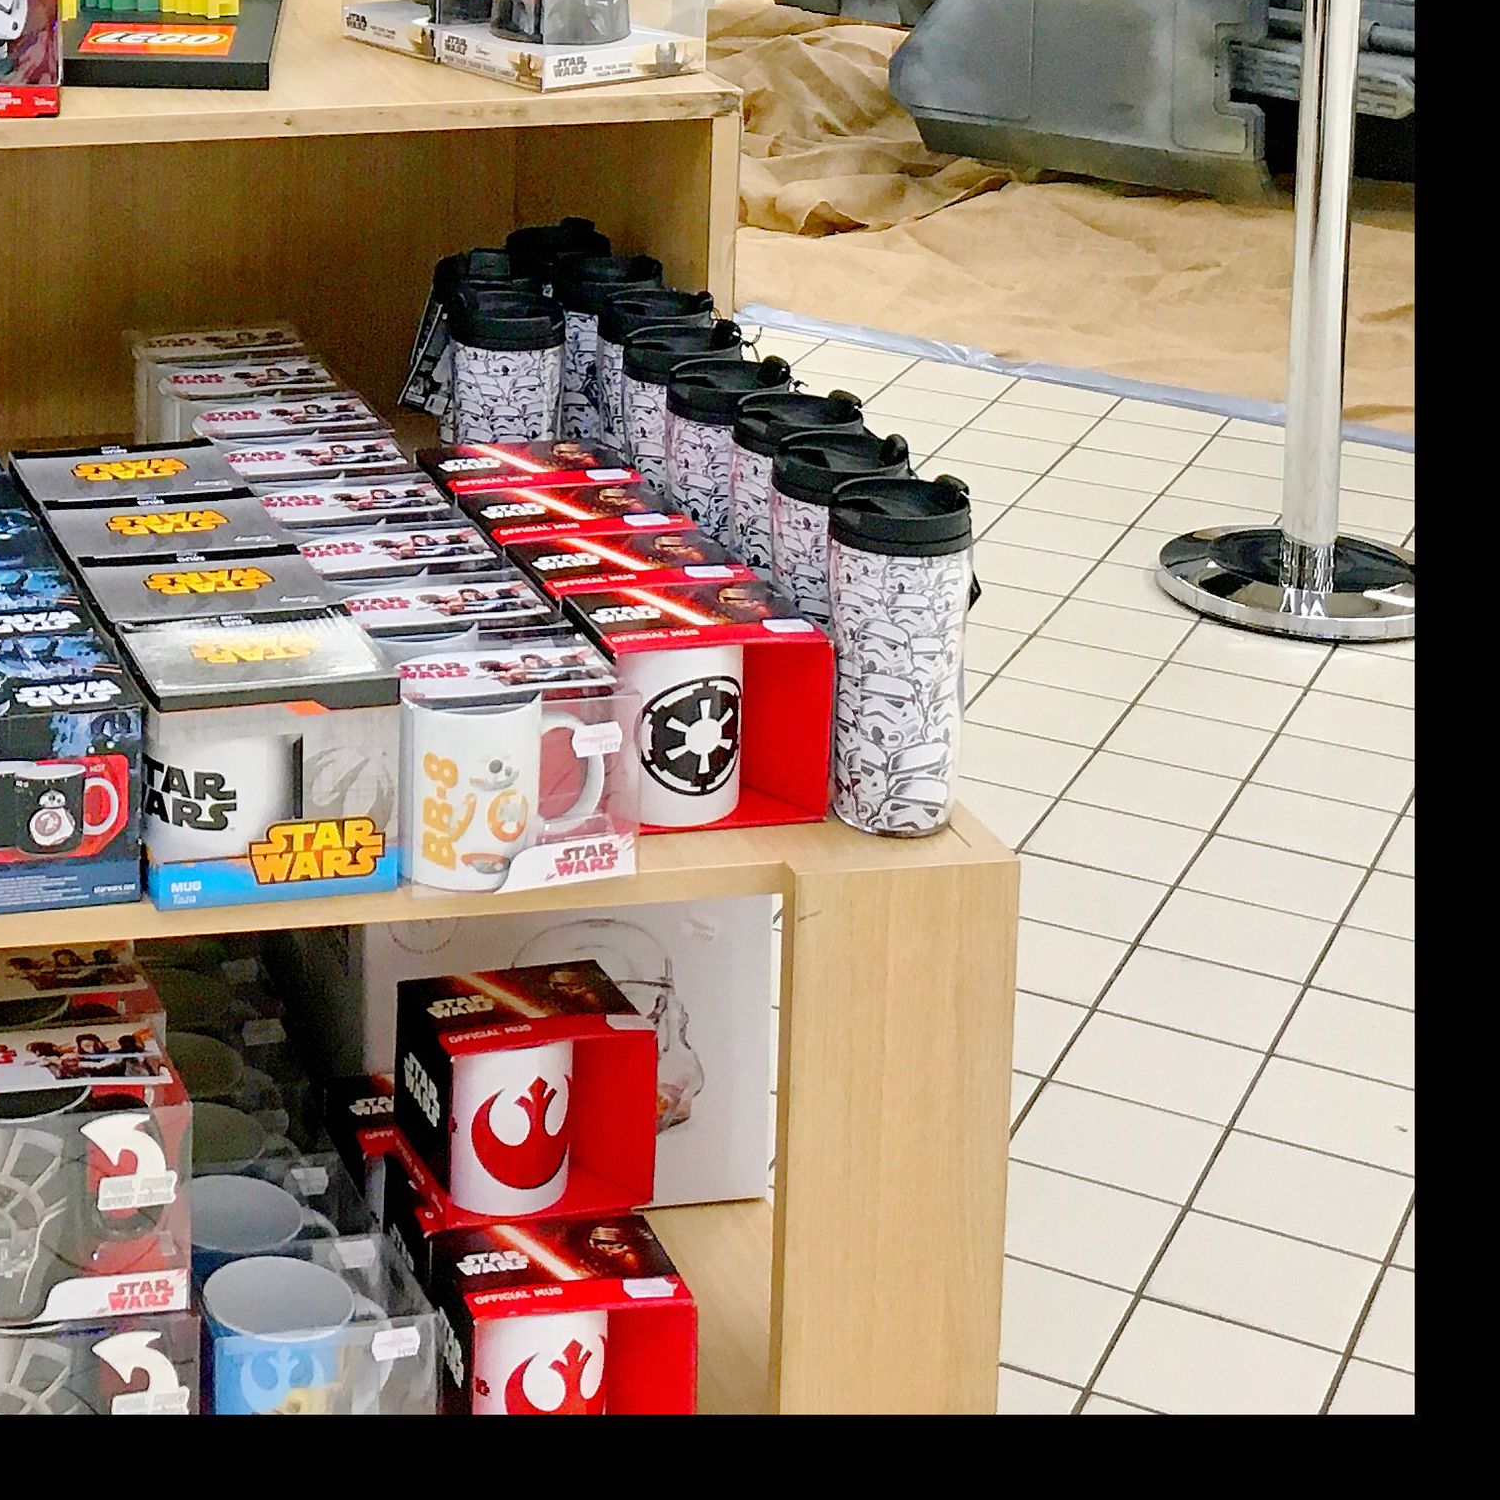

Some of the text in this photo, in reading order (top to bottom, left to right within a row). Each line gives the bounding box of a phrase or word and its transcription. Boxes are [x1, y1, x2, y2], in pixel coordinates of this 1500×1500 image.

[95, 32, 220, 46] LEGO
[444, 34, 467, 46] STAR
[444, 43, 467, 56] WARS
[553, 56, 587, 69] STAR
[553, 65, 587, 78] WARS
[438, 462, 499, 472] WARS
[455, 474, 533, 487] OFFICIAL MUG
[480, 509, 547, 521] WARS
[499, 522, 581, 538] OFFICIAL MUG
[301, 547, 364, 558] WARS
[531, 559, 600, 572] WARS
[142, 567, 275, 584] WARS
[553, 574, 637, 590] OFFICIAL MUG
[152, 581, 263, 596] STAR
[345, 602, 409, 613] WARS
[592, 606, 661, 616] STAR
[590, 612, 661, 626] WARS
[611, 627, 700, 644] OFFICIAL MUG
[16, 679, 122, 696] WARS
[14, 691, 112, 707] STAR
[89, 763, 106, 773] HOT
[143, 754, 237, 800] TAR
[143, 790, 237, 831] ARS
[421, 751, 458, 870] BB-8
[253, 819, 384, 856] STAR
[555, 842, 619, 861] STAR
[251, 847, 384, 884] WARS
[554, 856, 619, 877] WARS
[170, 881, 202, 893] MUG
[427, 1002, 494, 1018] WARS
[429, 995, 493, 1009] STAR
[448, 1024, 532, 1044] OFFICIAL MUG
[404, 1052, 438, 1101] STAR
[404, 1070, 440, 1127] WARS
[460, 1250, 529, 1264] STAR
[457, 1259, 529, 1275] WARS
[109, 1279, 174, 1298] STAR
[473, 1286, 563, 1305] OFFICIAL MUG
[108, 1293, 174, 1311] WARS
